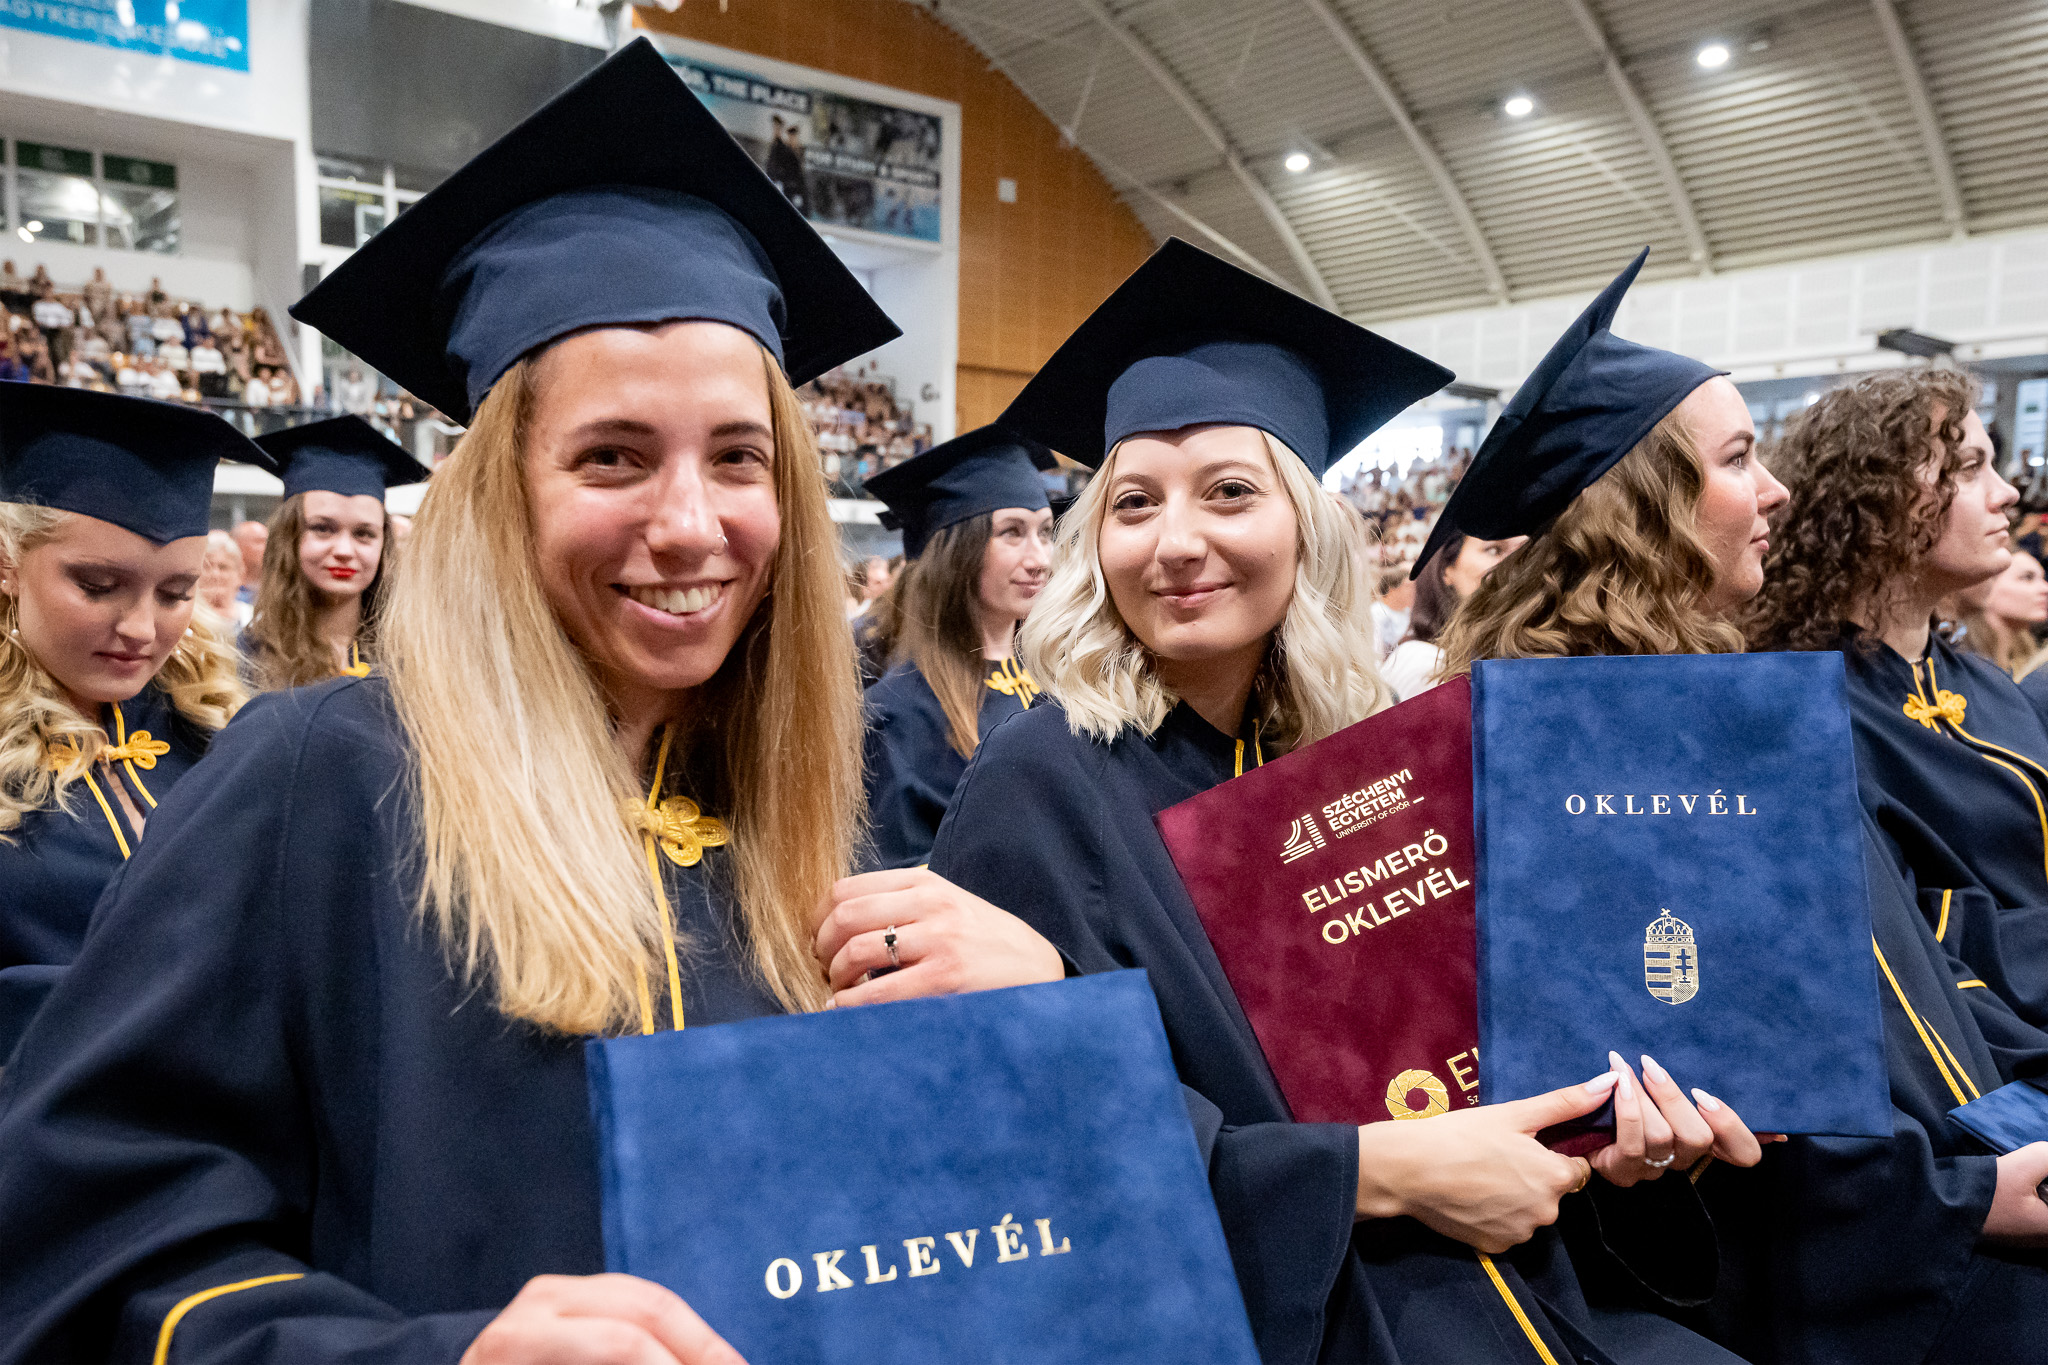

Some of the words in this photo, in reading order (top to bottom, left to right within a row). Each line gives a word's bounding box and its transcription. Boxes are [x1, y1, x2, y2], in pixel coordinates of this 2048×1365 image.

[751, 83, 807, 111] PLACE
[1322, 768, 1413, 819] SZÉCHENYI
[1328, 787, 1406, 832] EGYETEM
[1565, 788, 1757, 815] OKLEVÉL
[1335, 815, 1377, 839] UNIVERSITY
[1377, 810, 1389, 820] OF
[1302, 828, 1448, 914] ELISMERŐ
[1321, 867, 1471, 945] OKLEVÉL
[764, 1212, 1072, 1300] OKLEVÉL
